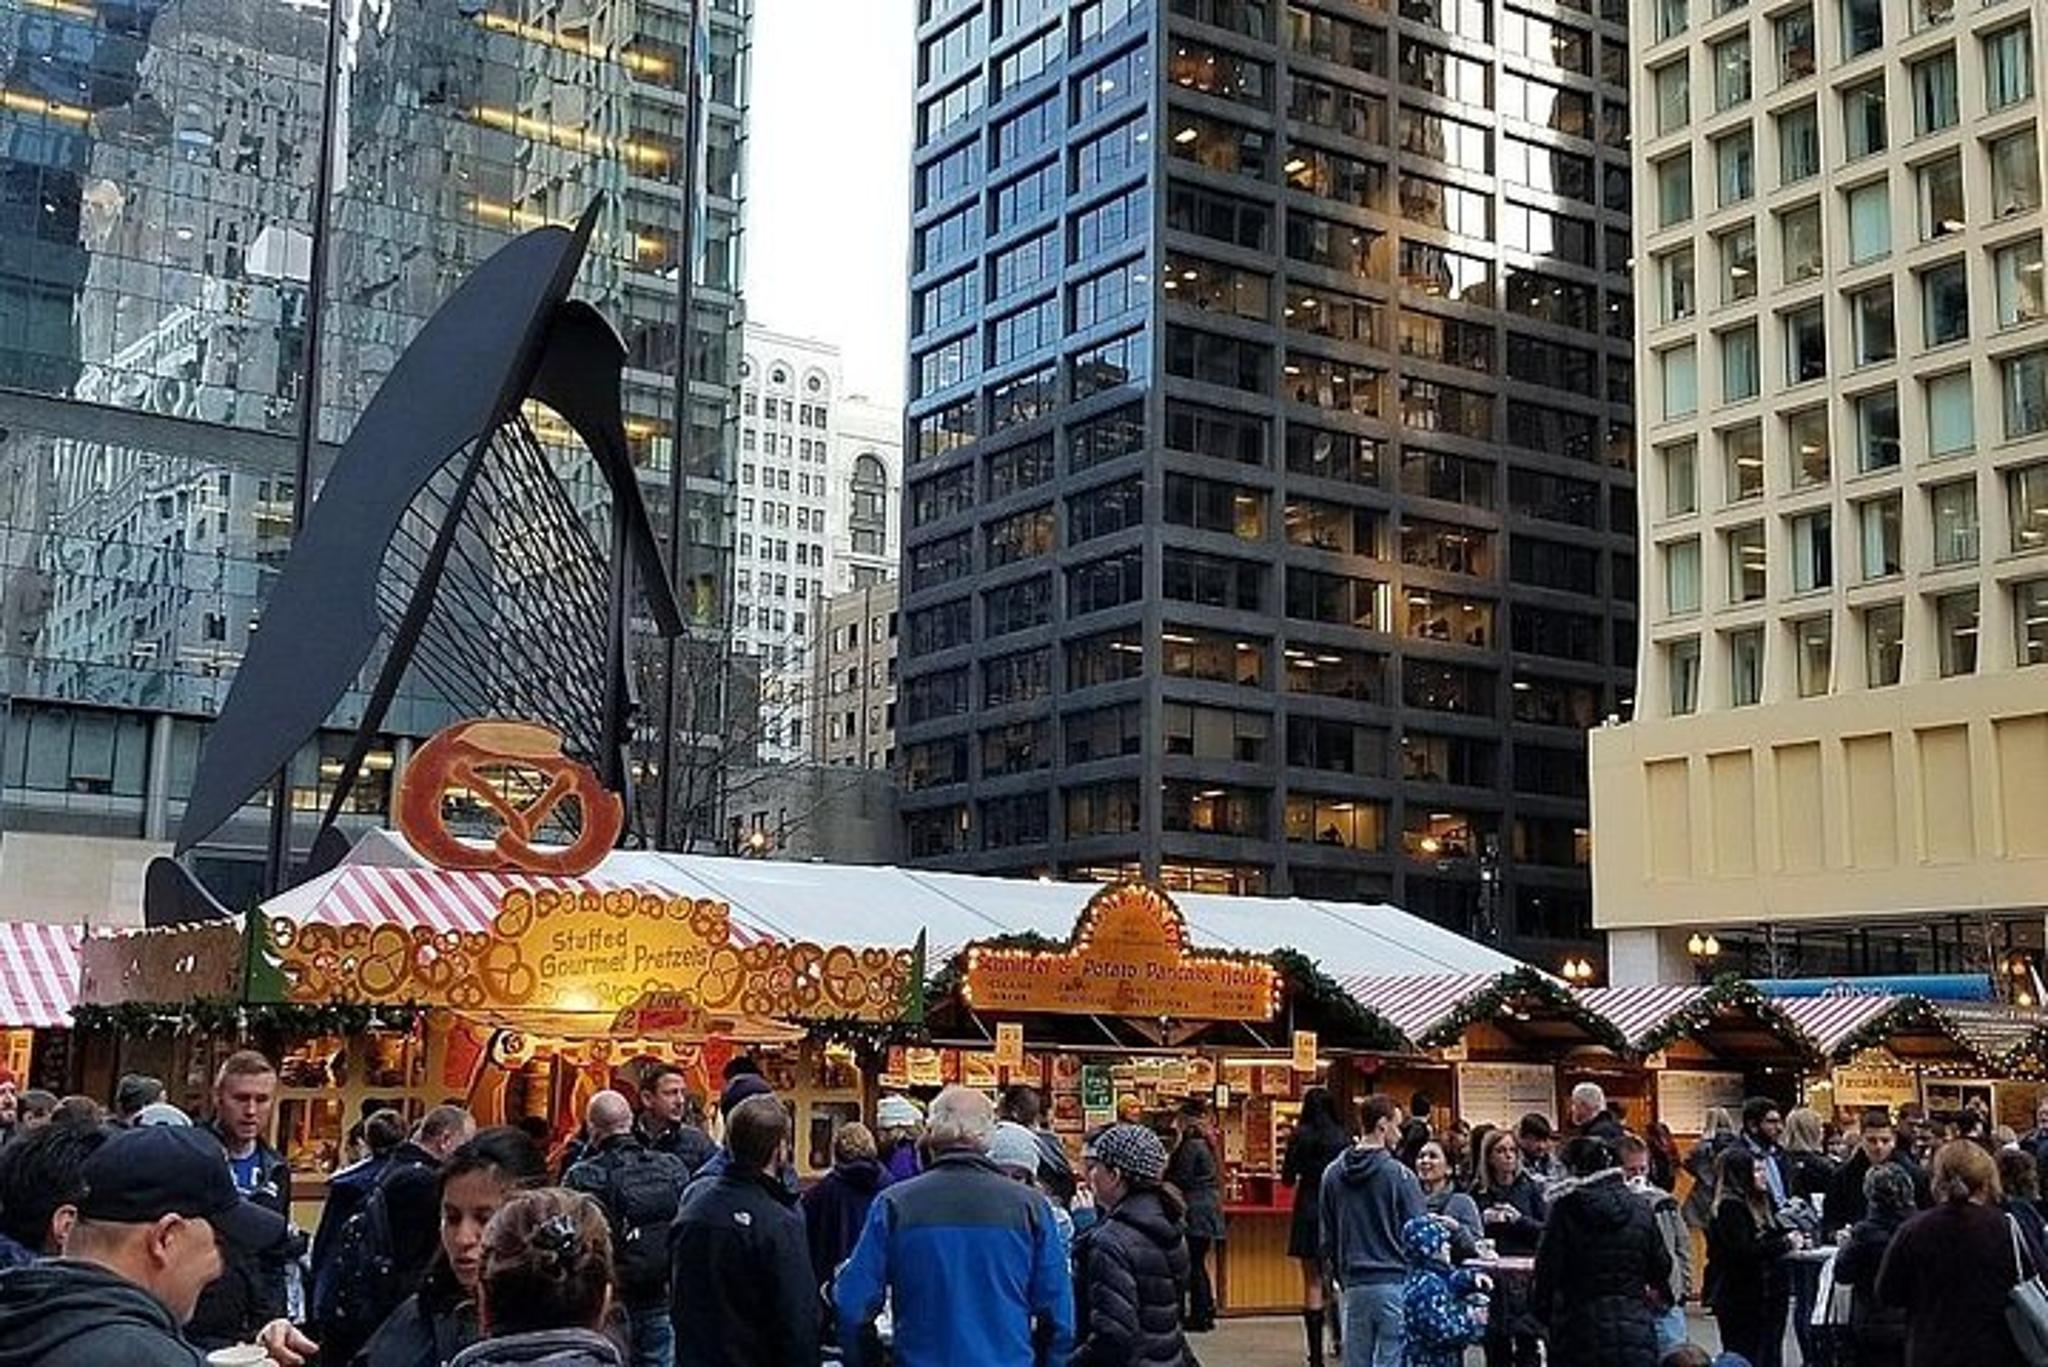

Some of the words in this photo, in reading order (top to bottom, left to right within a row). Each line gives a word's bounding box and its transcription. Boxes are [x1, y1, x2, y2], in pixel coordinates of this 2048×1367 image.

[552, 928, 628, 952] Stuffed
[540, 951, 628, 979] Gourmet
[633, 945, 708, 975] Pretzels
[1082, 959, 1138, 978] Potato
[1147, 961, 1213, 984] Pancake
